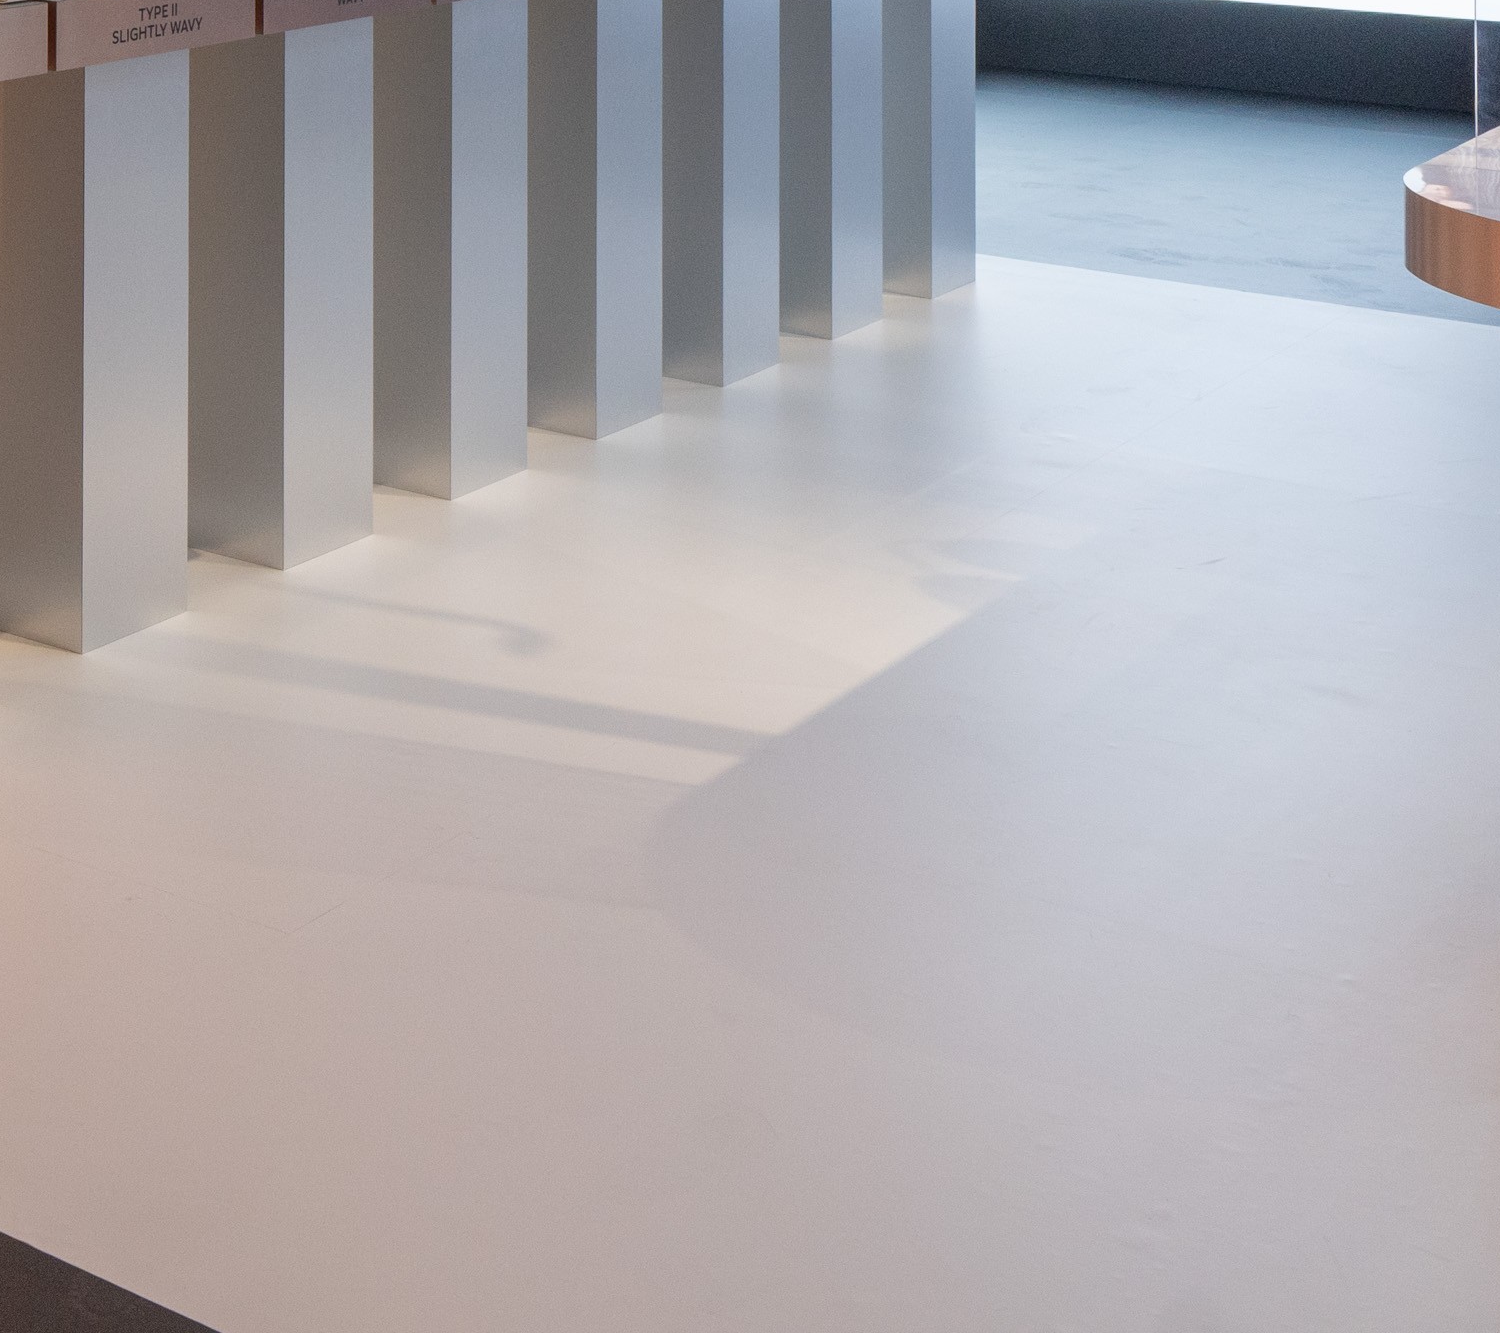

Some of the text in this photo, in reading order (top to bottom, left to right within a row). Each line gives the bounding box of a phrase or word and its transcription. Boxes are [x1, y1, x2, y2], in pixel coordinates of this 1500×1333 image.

[138, 2, 178, 22] TYPE II
[112, 16, 203, 45] SLIGHTLY WAVY
